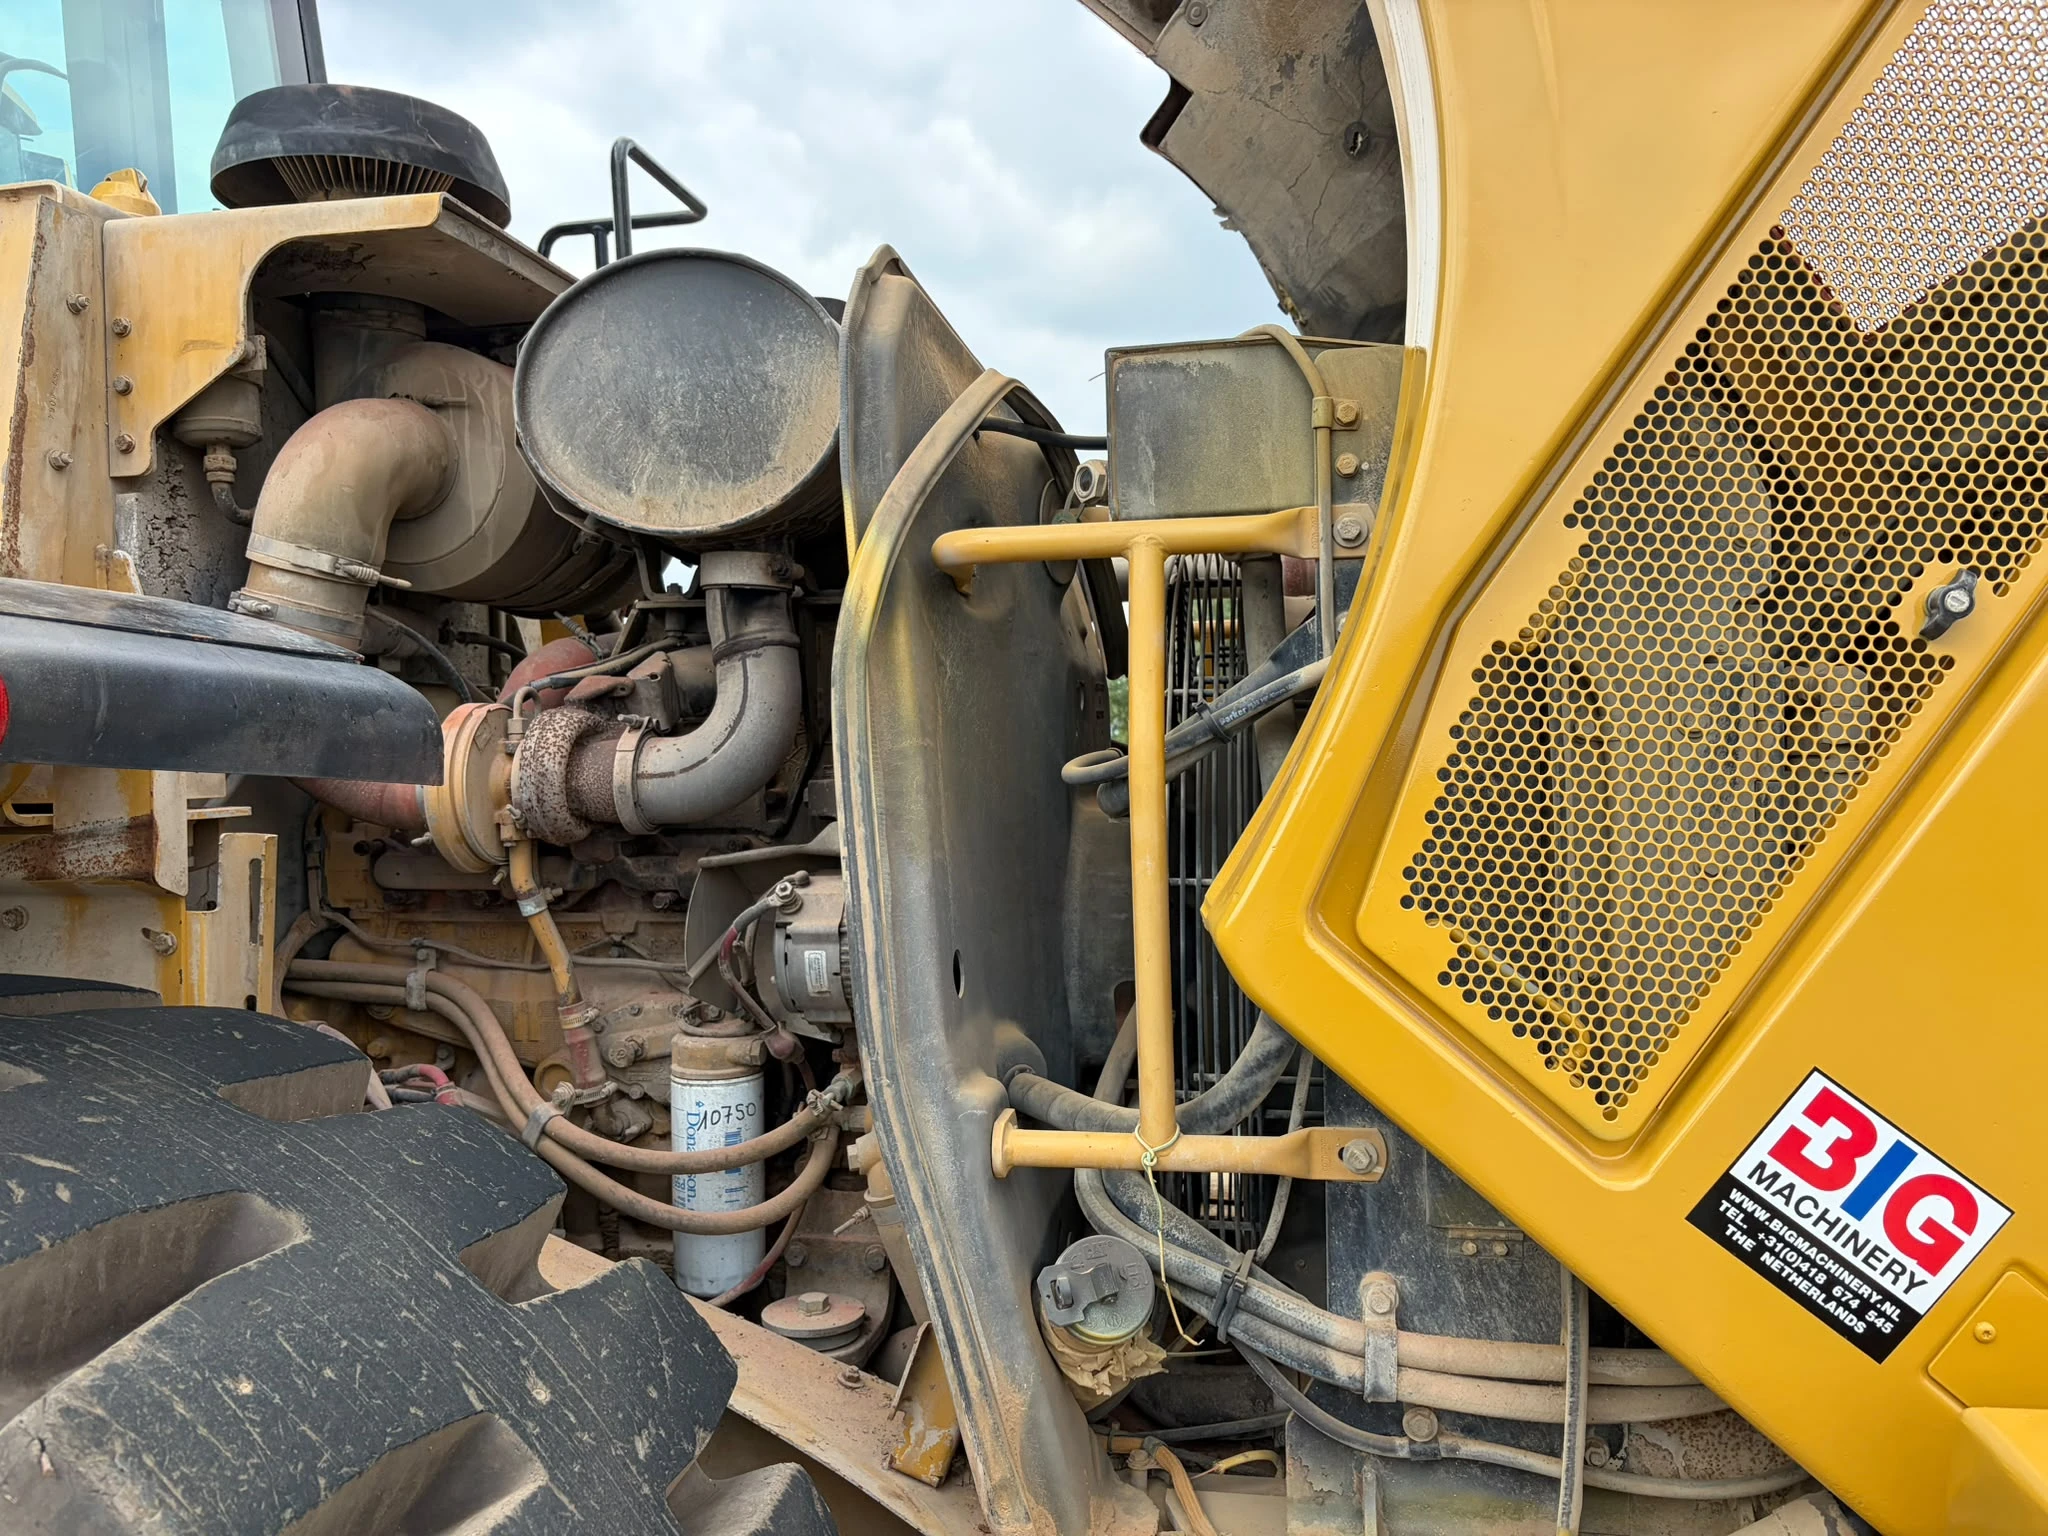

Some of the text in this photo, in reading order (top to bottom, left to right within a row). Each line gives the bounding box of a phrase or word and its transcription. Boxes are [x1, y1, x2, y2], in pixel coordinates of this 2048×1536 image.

[1220, 707, 1248, 726] Parker
[687, 1111, 701, 1202] Donason.
[697, 1102, 757, 1131] 10750
[1718, 1199, 1895, 1334] TEL. +31(0)418 674 545
[1724, 1224, 1867, 1334] THE NETHERLANDS
[1728, 1187, 1901, 1322] WWW.BIGMACHINERY.NL
[1747, 1160, 1929, 1295] MACHINERY
